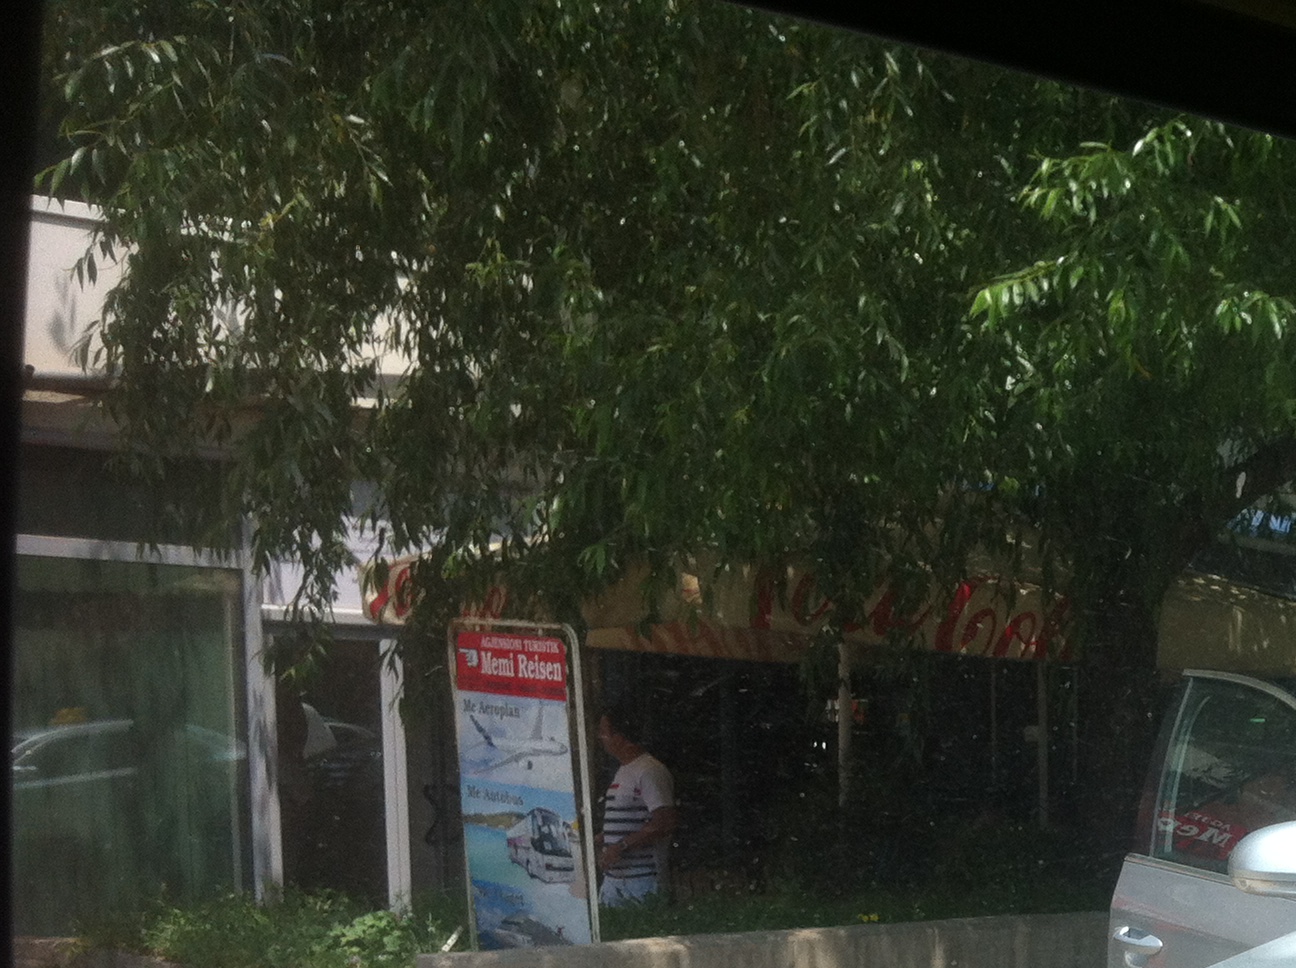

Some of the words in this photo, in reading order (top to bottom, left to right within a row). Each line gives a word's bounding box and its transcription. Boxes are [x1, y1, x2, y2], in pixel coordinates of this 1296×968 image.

[481, 650, 515, 678] Memi
[518, 653, 562, 682] Reisen
[479, 701, 521, 720] Aeroplan
[484, 788, 524, 806] Autobus
